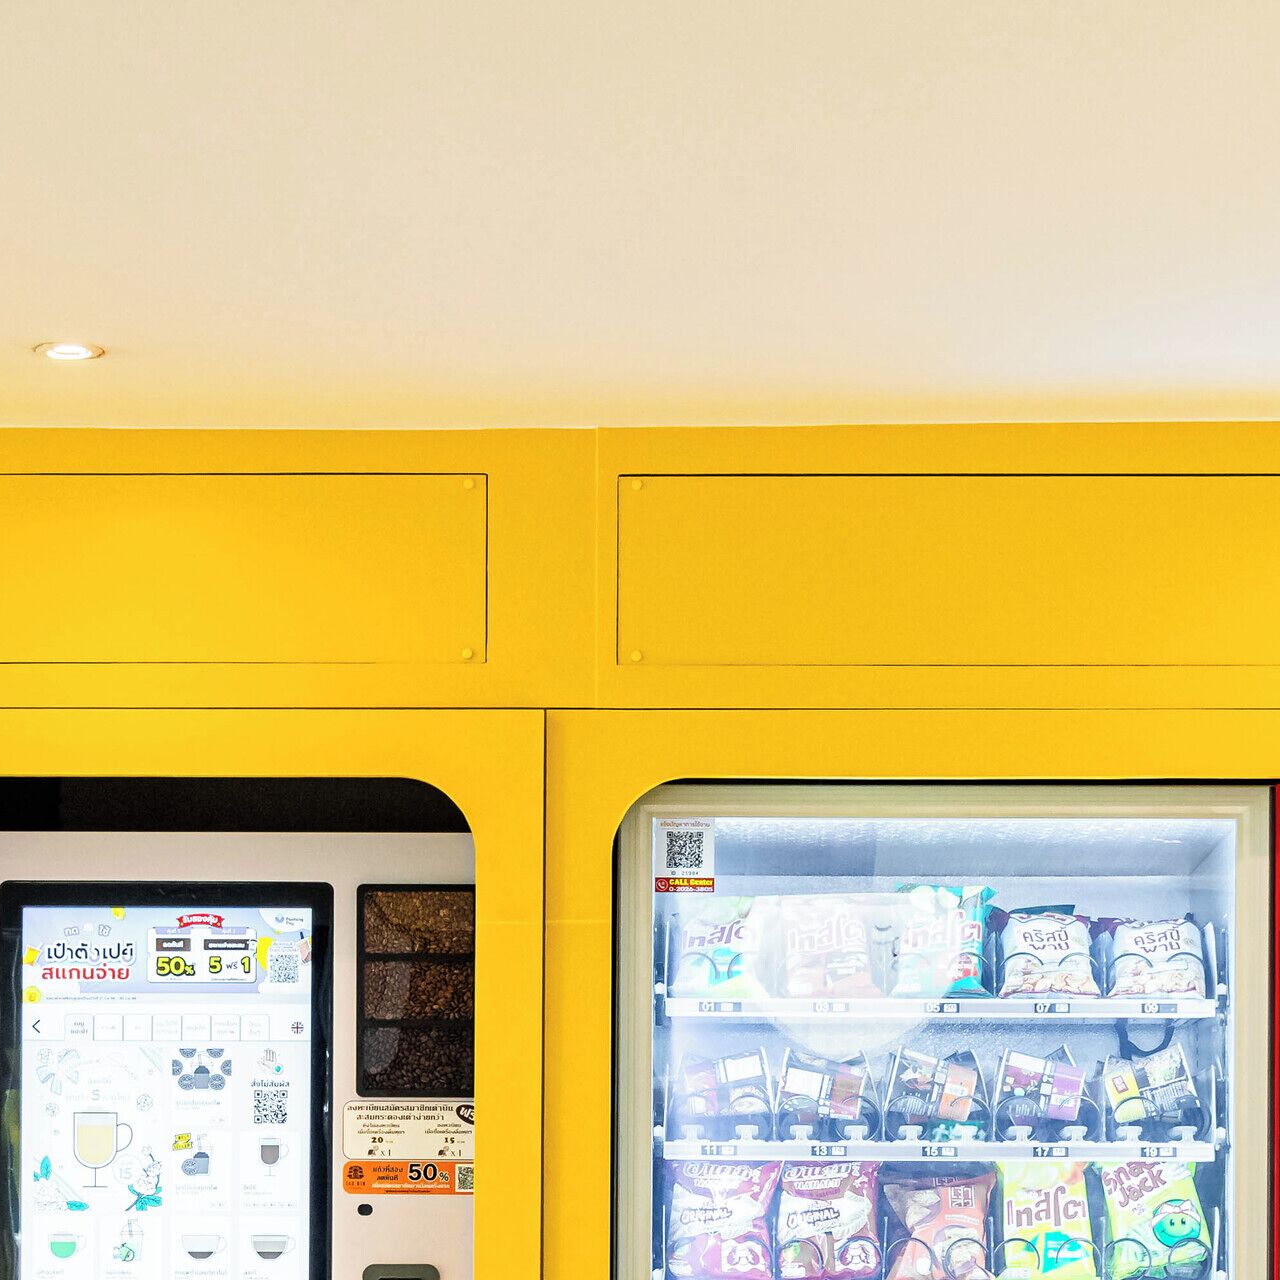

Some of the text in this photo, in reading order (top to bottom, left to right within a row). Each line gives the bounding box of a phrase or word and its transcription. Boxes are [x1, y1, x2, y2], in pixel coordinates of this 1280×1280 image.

[1022, 926, 1069, 943] คริสปี้
[1134, 926, 1180, 946] คริสปี้
[1140, 942, 1180, 953] พาย
[41, 963, 131, 981] สแกนจ่าย
[209, 956, 222, 974] 5
[241, 956, 250, 974] 1
[1036, 1002, 1050, 1013] 07
[1144, 1002, 1158, 1013] 09
[1035, 1145, 1049, 1156] 17
[408, 1163, 449, 1182] 50%
[1119, 1169, 1167, 1207] Jack
